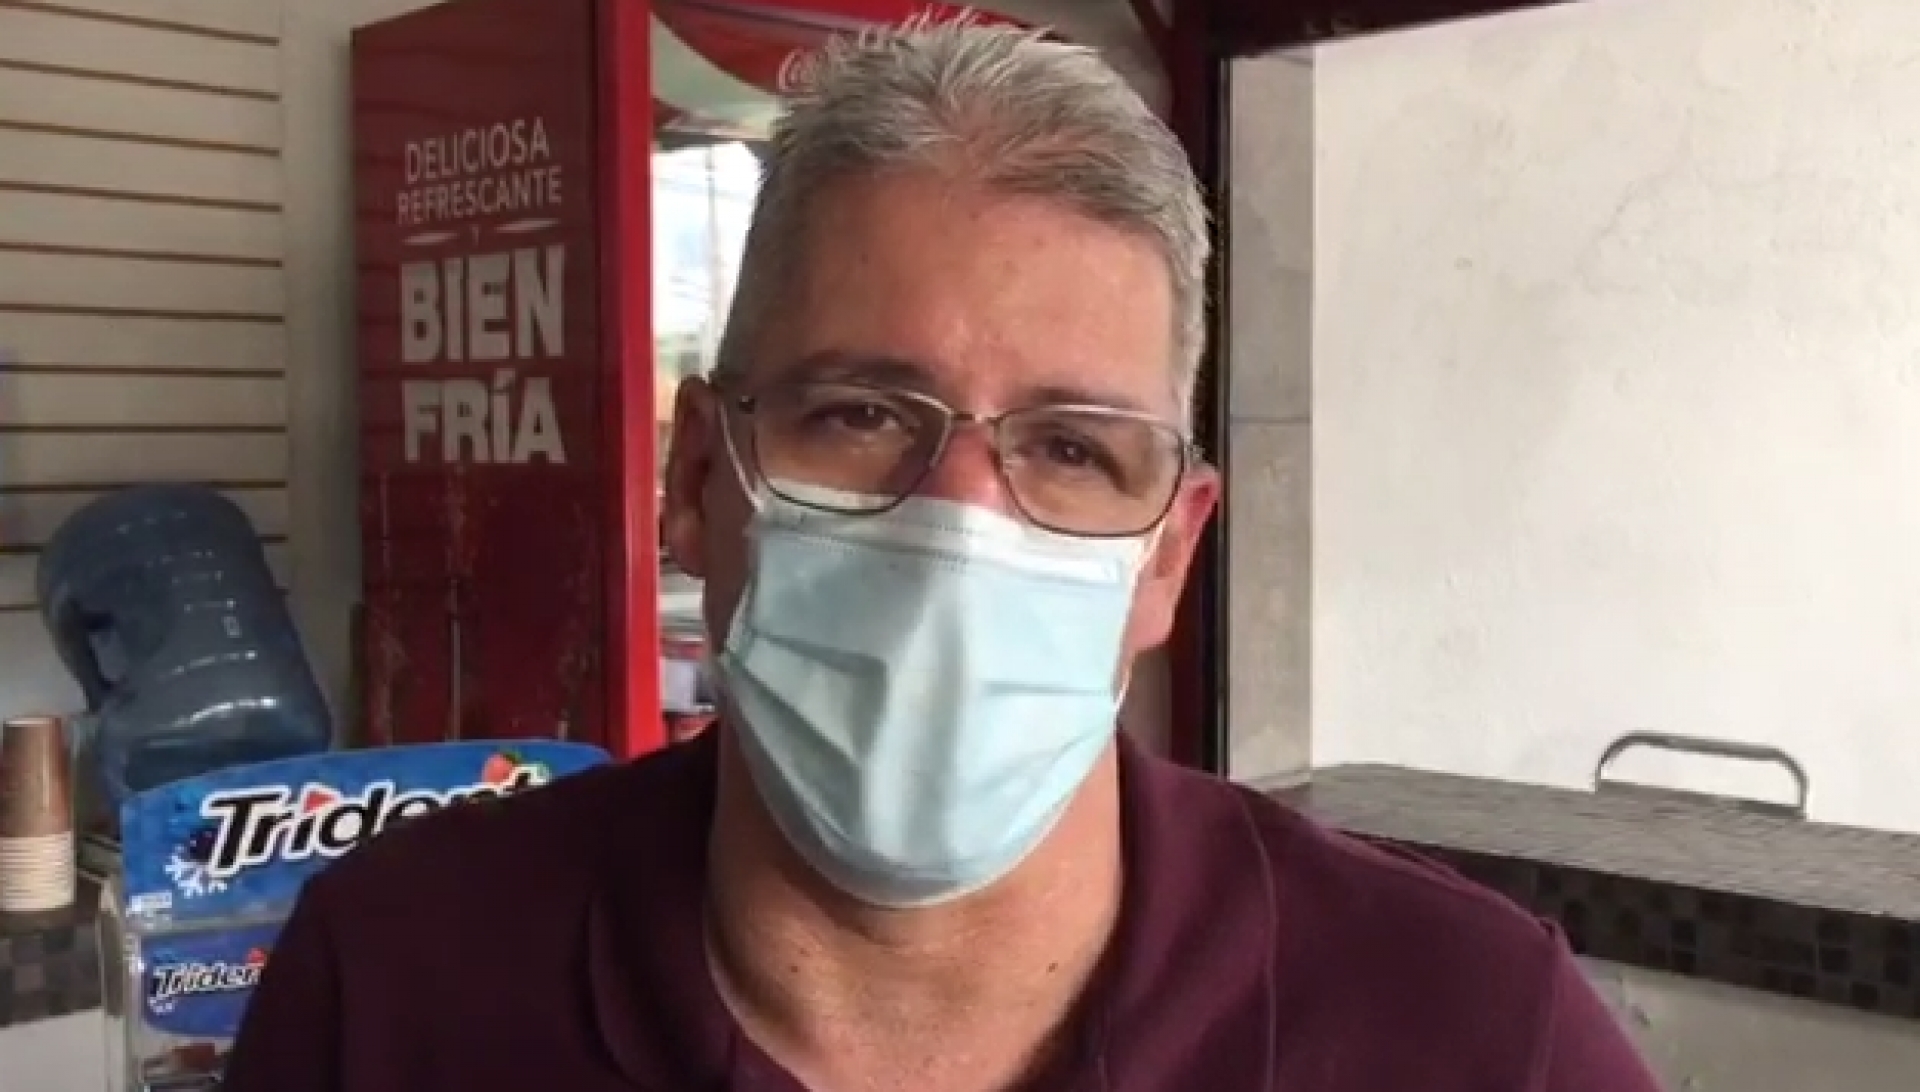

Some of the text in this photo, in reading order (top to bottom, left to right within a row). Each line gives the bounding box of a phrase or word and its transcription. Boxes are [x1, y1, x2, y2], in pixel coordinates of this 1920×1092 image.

[405, 117, 550, 184] DELICIOSA
[397, 166, 562, 226] REFRESCANTE
[401, 244, 565, 363] BIEN
[402, 367, 567, 464] FRÍA
[202, 766, 548, 877] Tride
[153, 960, 262, 998] Triden
